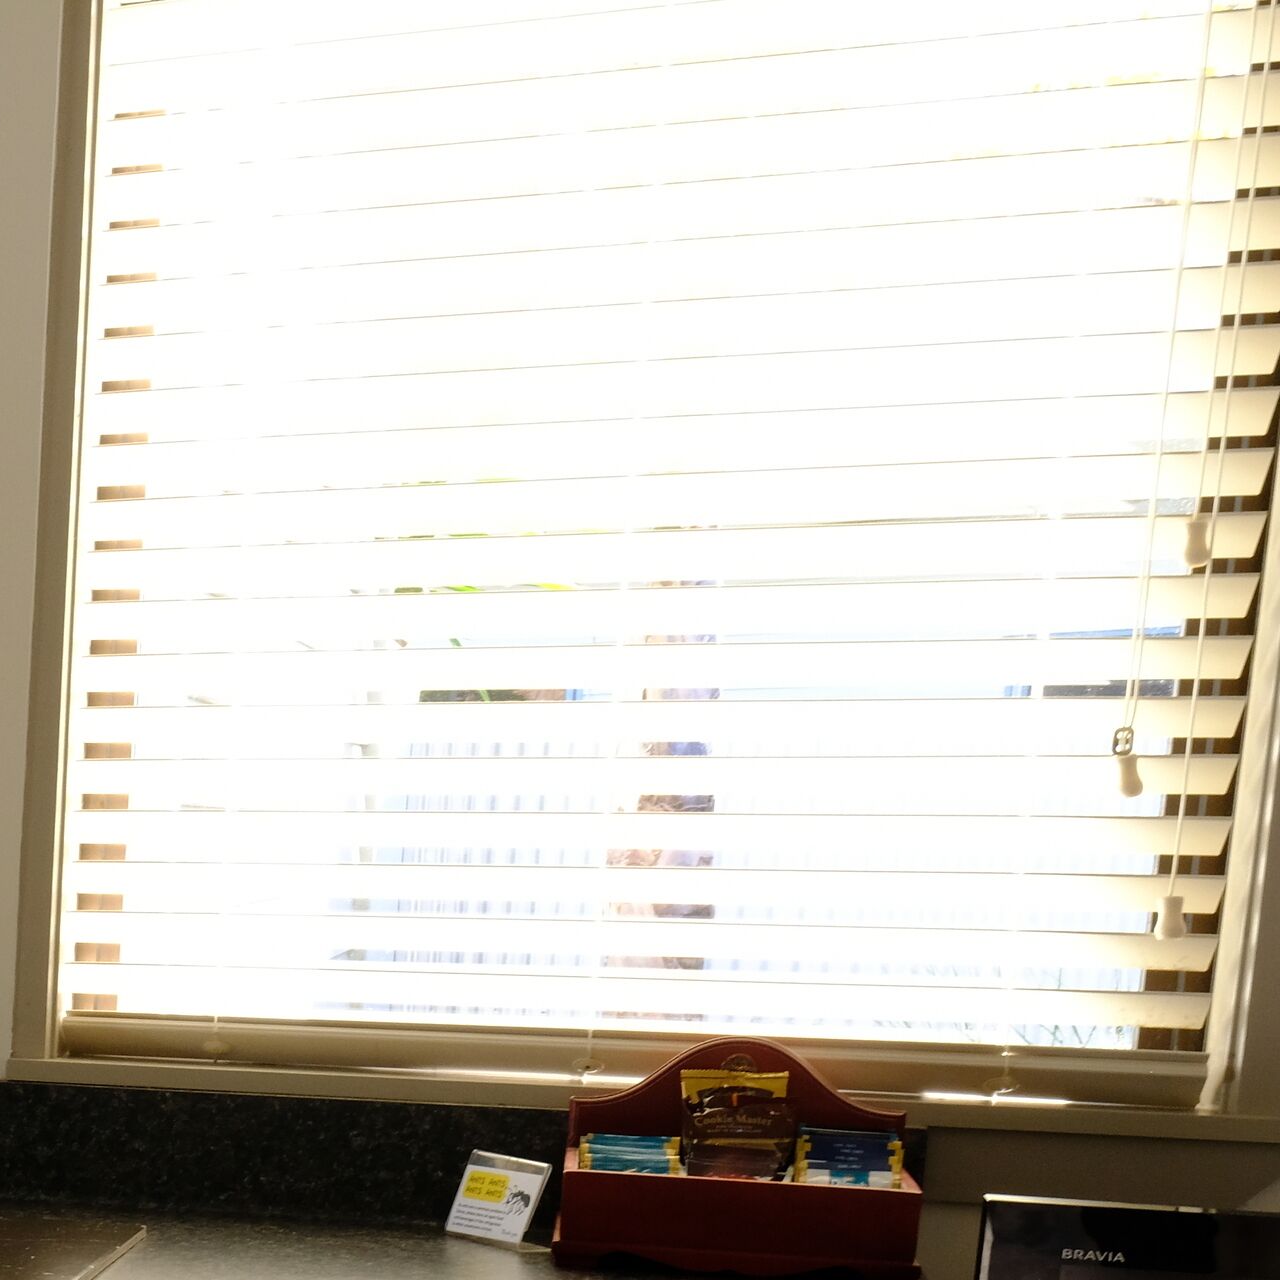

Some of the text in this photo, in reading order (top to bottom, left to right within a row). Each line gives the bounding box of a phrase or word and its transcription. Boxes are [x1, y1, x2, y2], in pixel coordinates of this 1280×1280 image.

[694, 1113, 773, 1128] Cookie Master
[1061, 1247, 1126, 1263] BRAVIA
